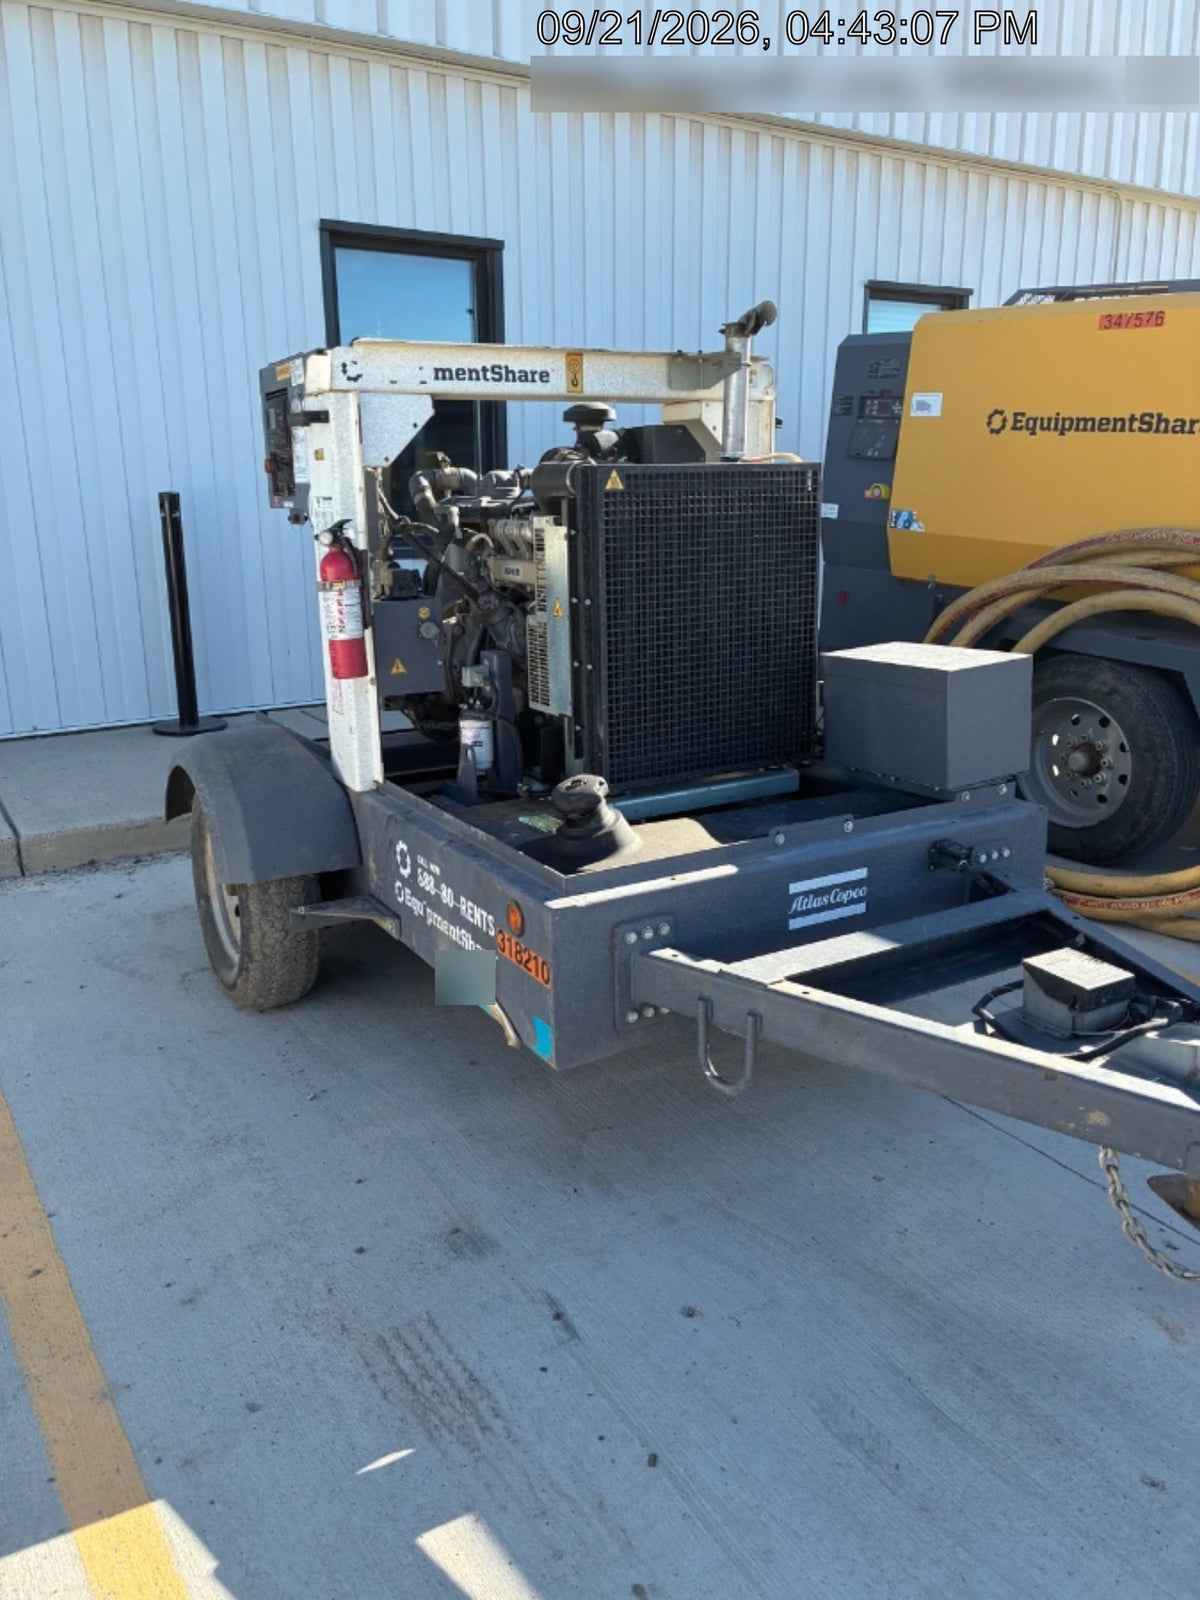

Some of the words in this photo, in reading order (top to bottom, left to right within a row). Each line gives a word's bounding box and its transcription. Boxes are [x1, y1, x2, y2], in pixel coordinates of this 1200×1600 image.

[390, 363, 550, 384] mentShare
[1011, 411, 1200, 436] EquipmentShar
[497, 928, 551, 986] 318210
